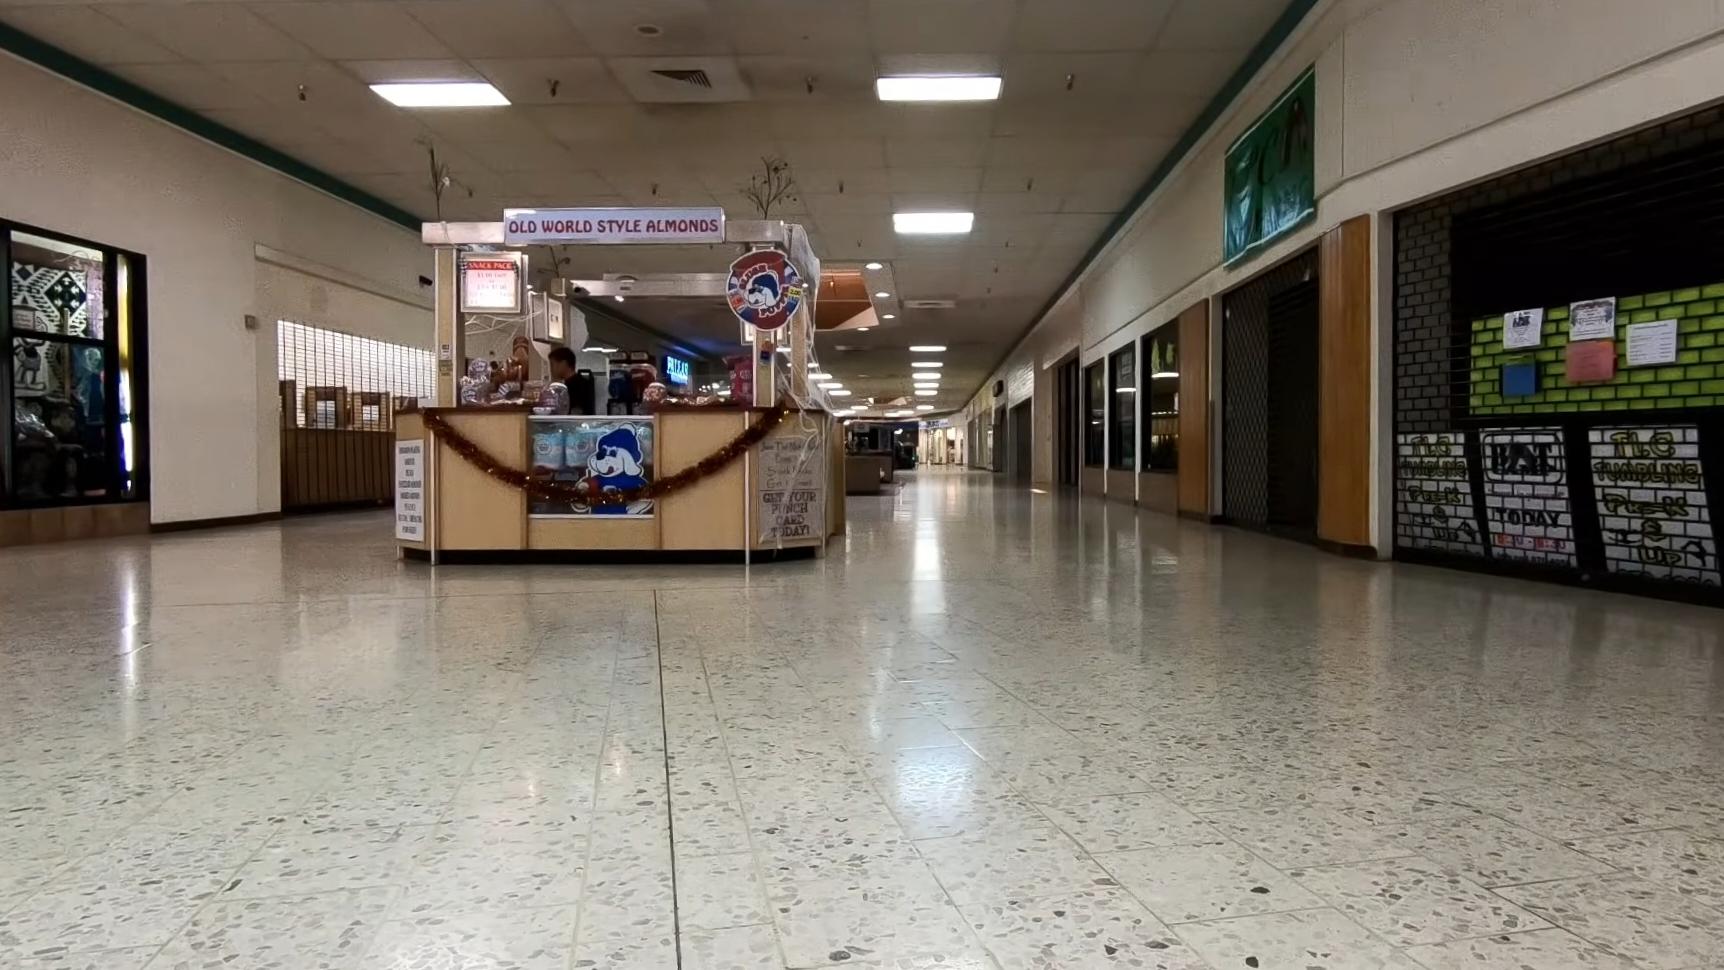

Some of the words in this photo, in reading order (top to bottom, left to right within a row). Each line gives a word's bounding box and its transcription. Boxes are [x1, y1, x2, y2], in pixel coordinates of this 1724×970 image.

[508, 220, 537, 233] OLD
[541, 220, 593, 233] WORLD
[597, 219, 641, 233] STYLE
[645, 219, 719, 233] ALMONDS
[790, 492, 816, 502] YOUR
[1496, 508, 1560, 528] TODAY
